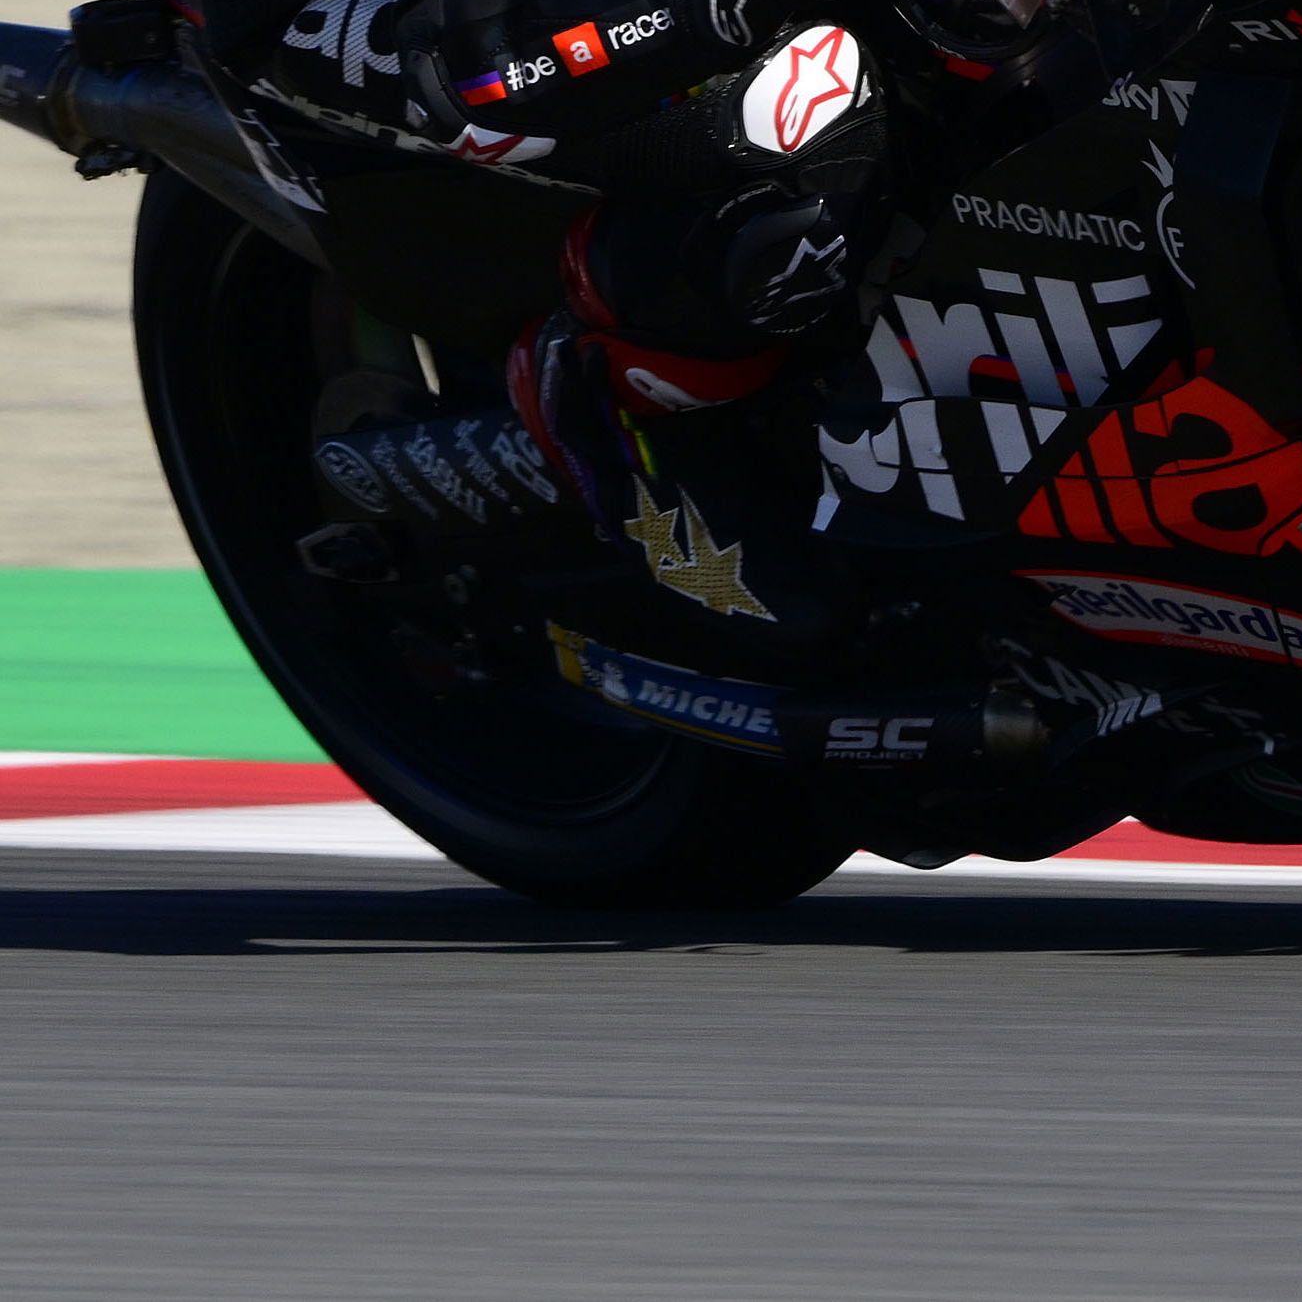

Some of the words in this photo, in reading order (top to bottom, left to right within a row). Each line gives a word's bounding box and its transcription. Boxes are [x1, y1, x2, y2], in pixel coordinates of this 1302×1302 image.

[506, 55, 556, 91] #be
[569, 40, 594, 63] a
[952, 193, 1146, 252] PRAGMATIC
[638, 679, 779, 738] MICHE
[824, 717, 935, 752] SC
[824, 751, 927, 763] PROJECT
